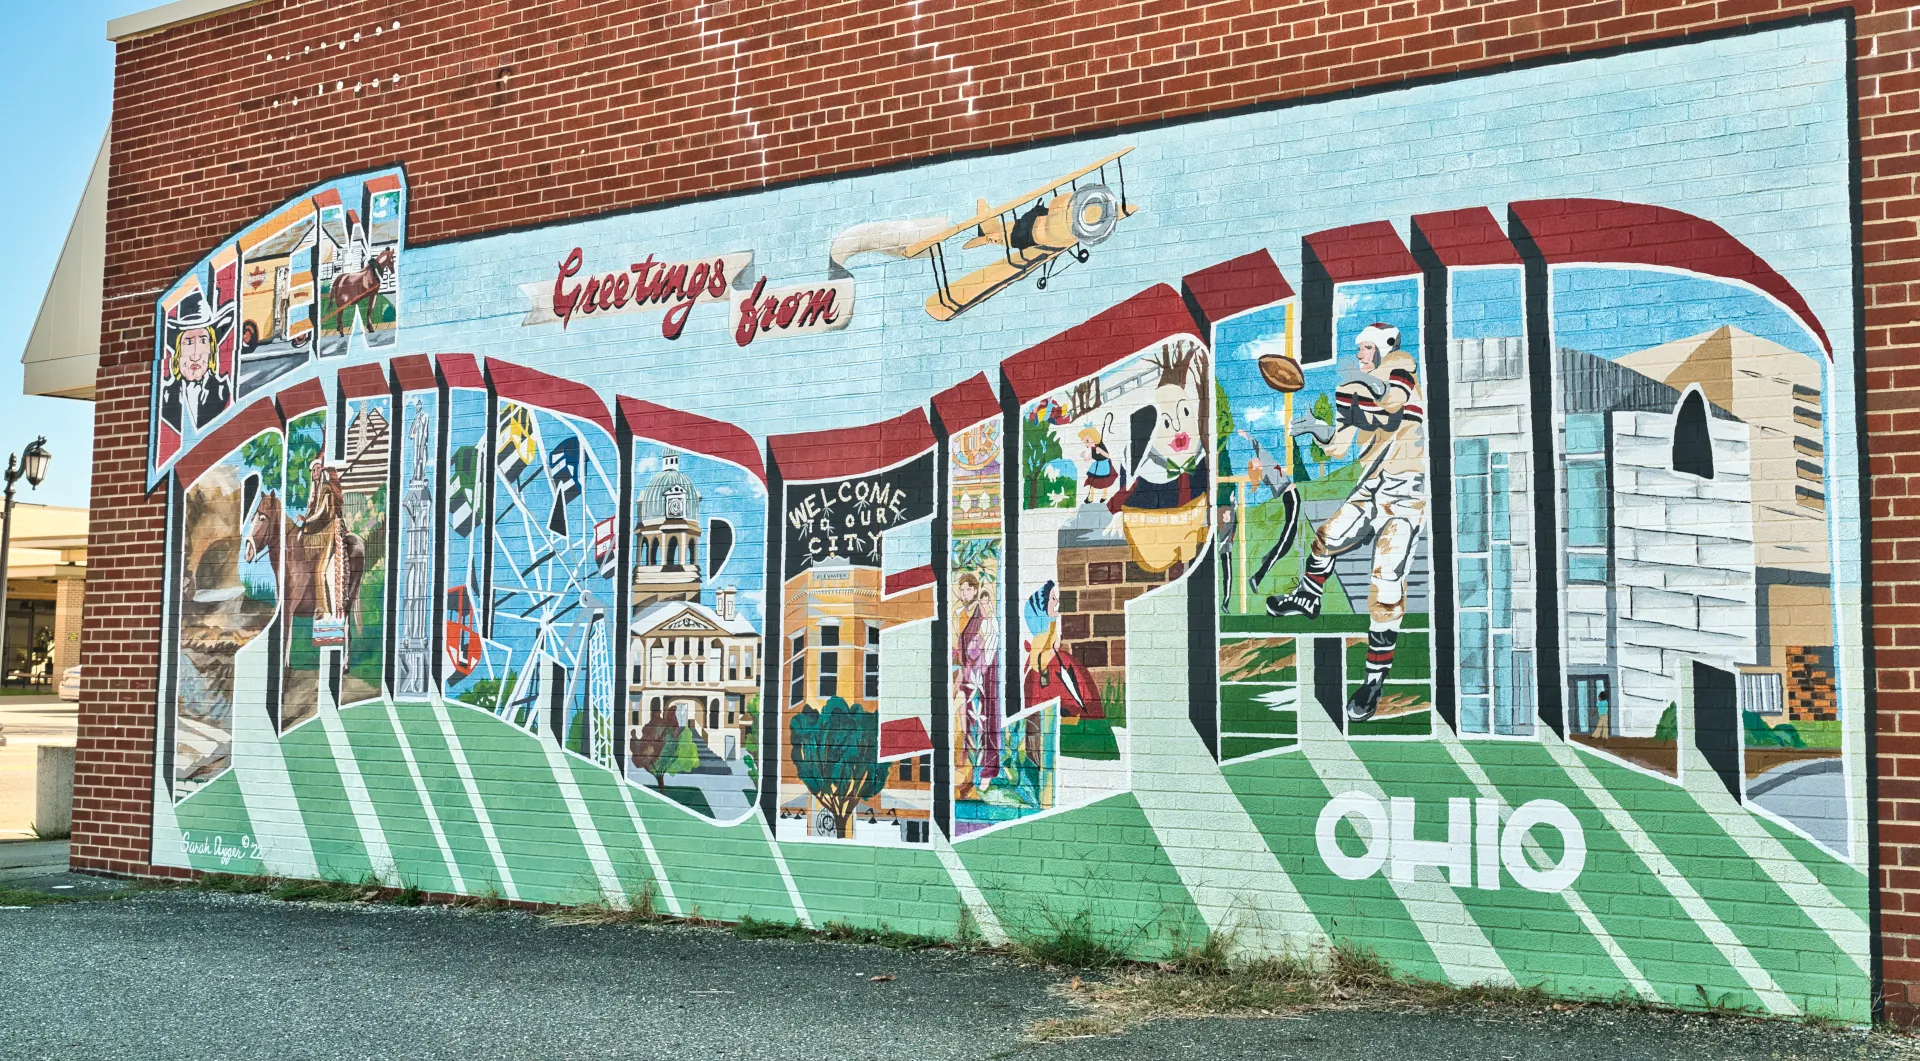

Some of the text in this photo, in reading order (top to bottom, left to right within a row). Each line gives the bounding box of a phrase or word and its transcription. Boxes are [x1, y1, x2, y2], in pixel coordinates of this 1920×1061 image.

[154, 174, 403, 475] NEW
[552, 246, 728, 341] Greetings
[734, 275, 840, 348] from
[164, 200, 1857, 864] PHILADELPHIA
[788, 481, 907, 529] WELCOME
[807, 507, 887, 533] TO OUR
[808, 530, 883, 554] CITY
[180, 831, 213, 855] Sarah
[1315, 790, 1588, 893] OHIO
